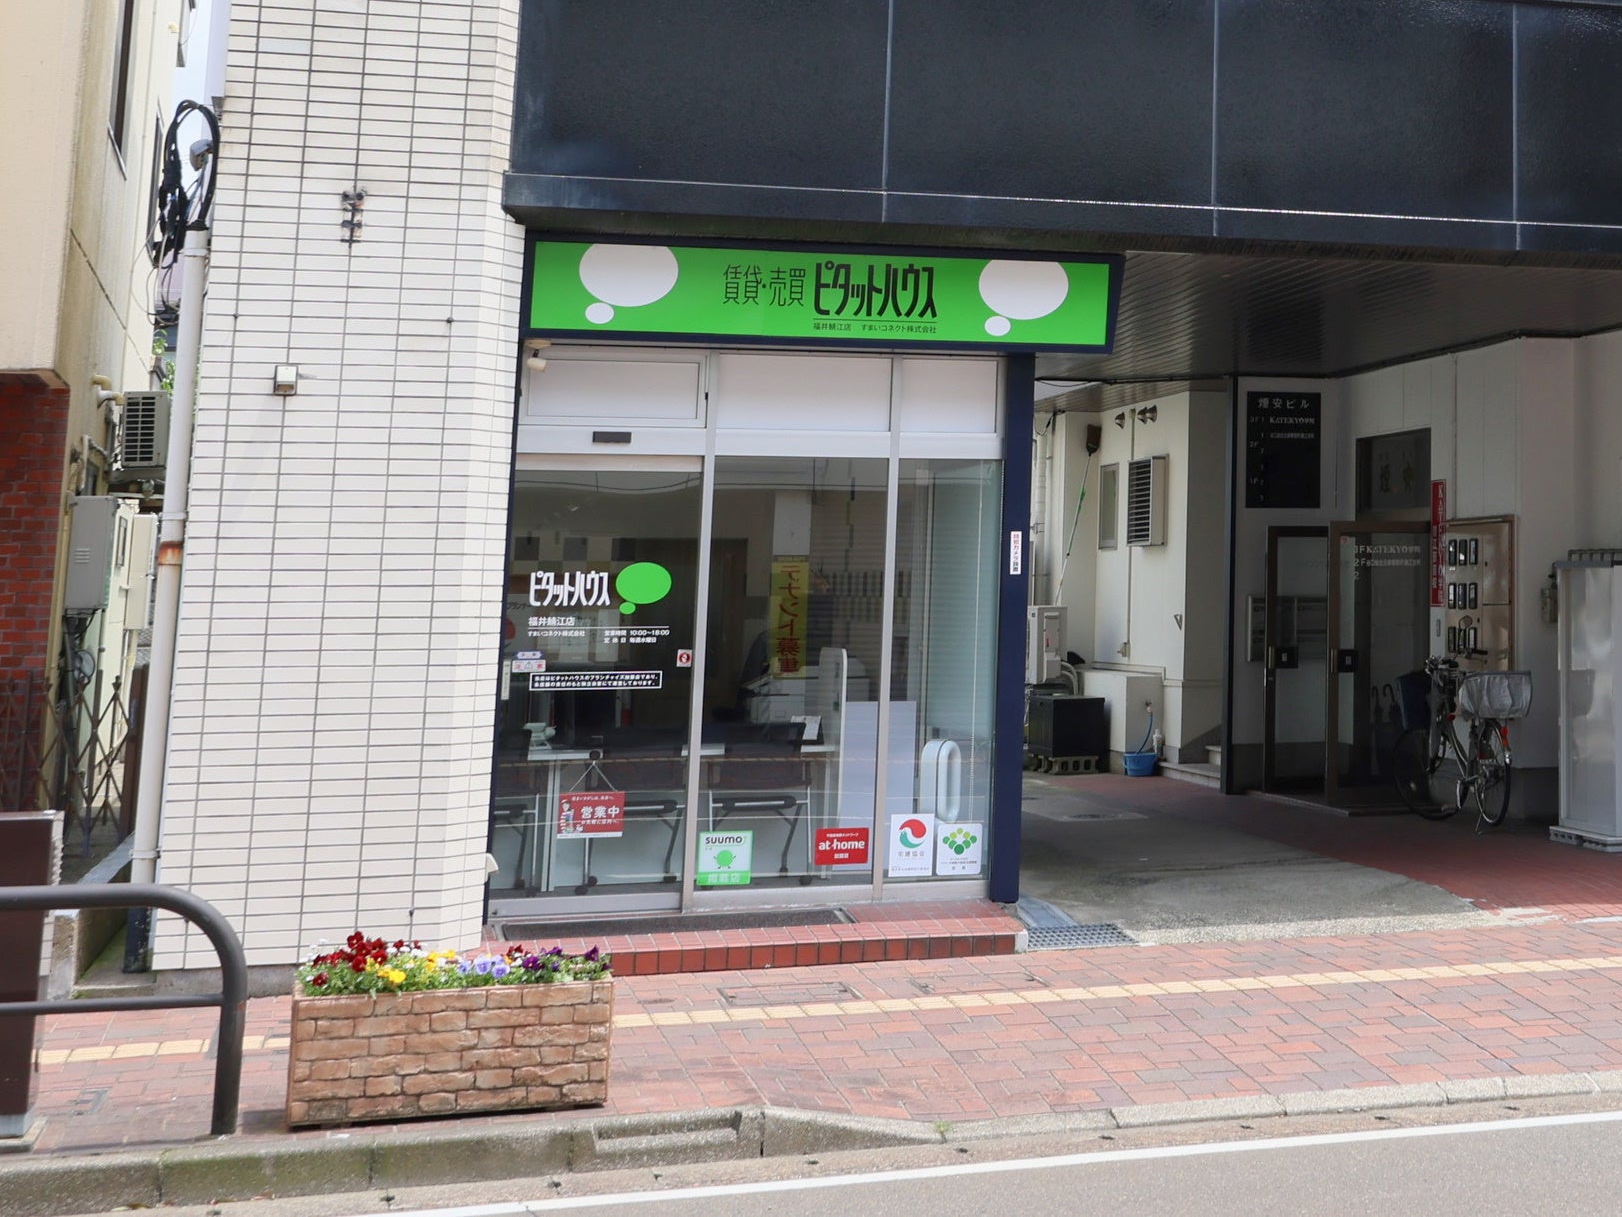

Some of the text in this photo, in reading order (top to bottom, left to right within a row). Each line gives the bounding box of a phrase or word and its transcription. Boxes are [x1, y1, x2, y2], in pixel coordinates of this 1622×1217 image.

[813, 261, 938, 318] ピタットハウス
[813, 322, 937, 334] 福井鯖江店 すまいコネクト株式会社
[529, 570, 611, 607] ピタットハウス
[528, 616, 575, 626] 福井鯖江店
[580, 805, 620, 819] 営業中
